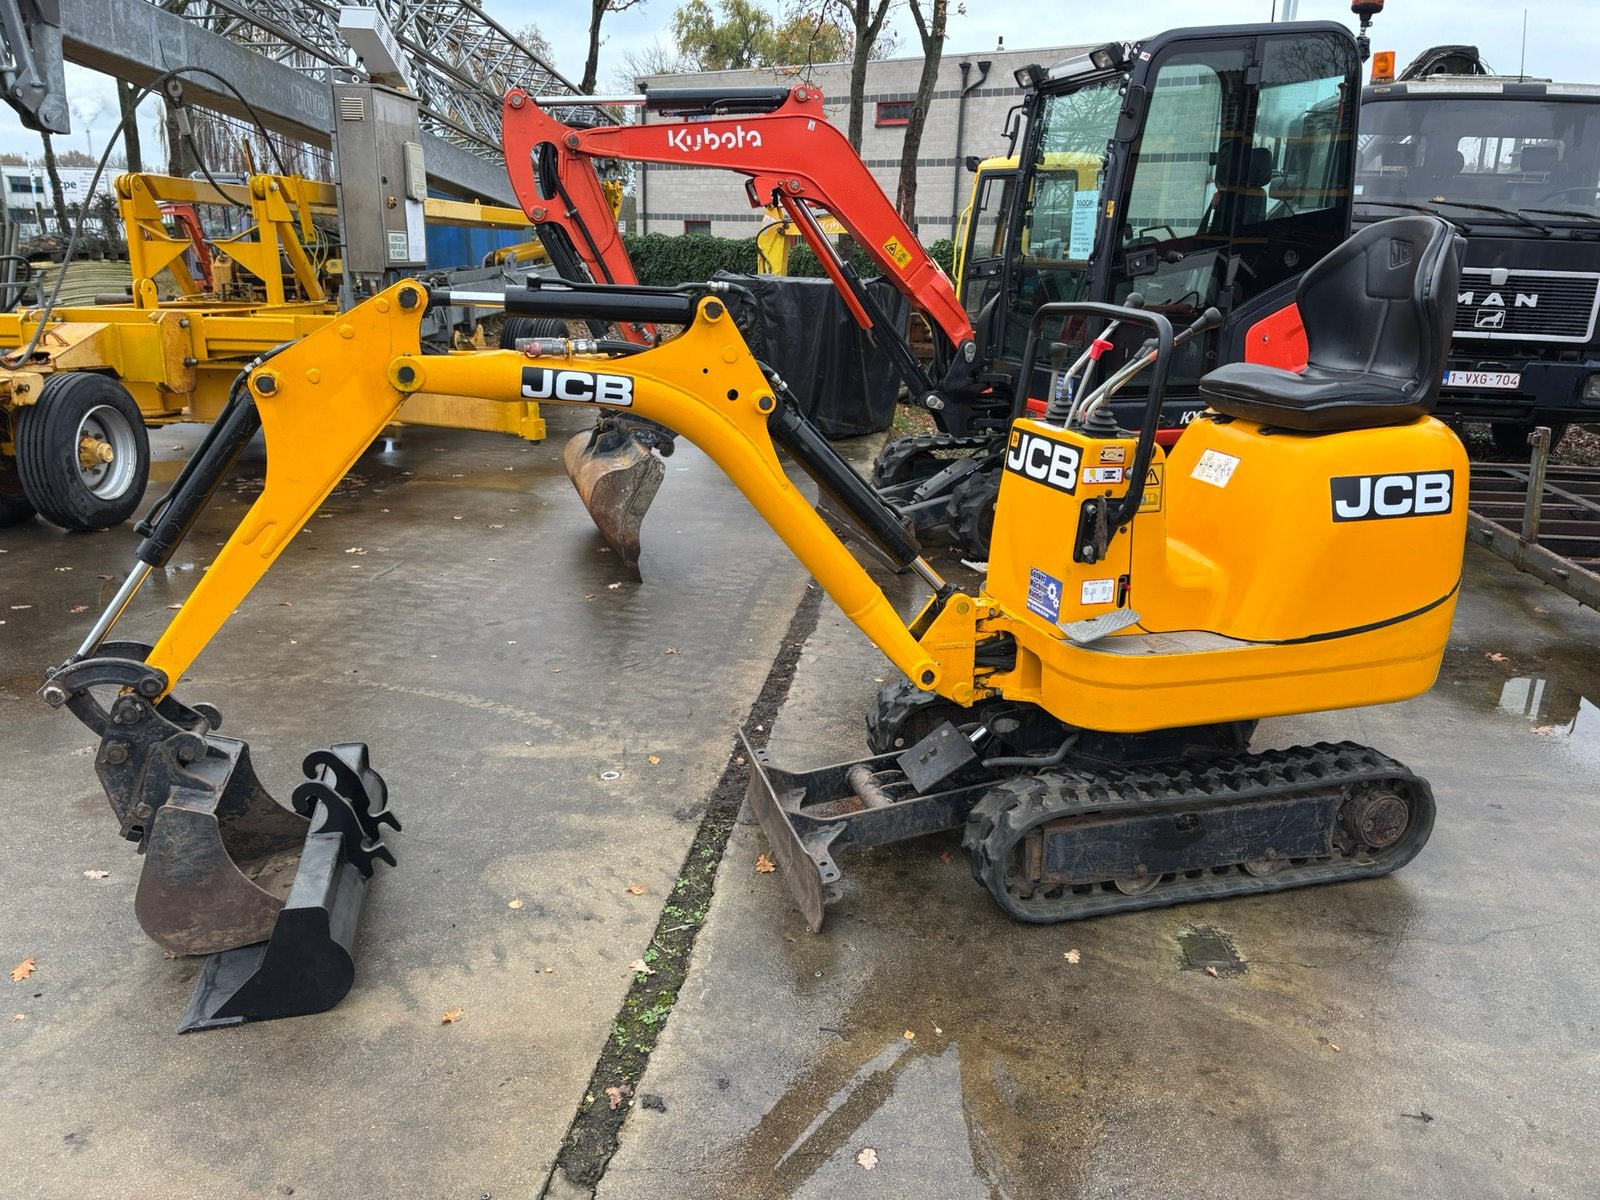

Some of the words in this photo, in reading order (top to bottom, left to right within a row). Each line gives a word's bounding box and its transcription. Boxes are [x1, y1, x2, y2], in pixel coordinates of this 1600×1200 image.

[667, 125, 762, 152] Kubota
[1457, 291, 1539, 308] MAN
[522, 369, 633, 406] JCB
[1451, 373, 1518, 386] 1-VXG-704
[1008, 434, 1079, 490] JCB
[1335, 473, 1451, 518] JCB
